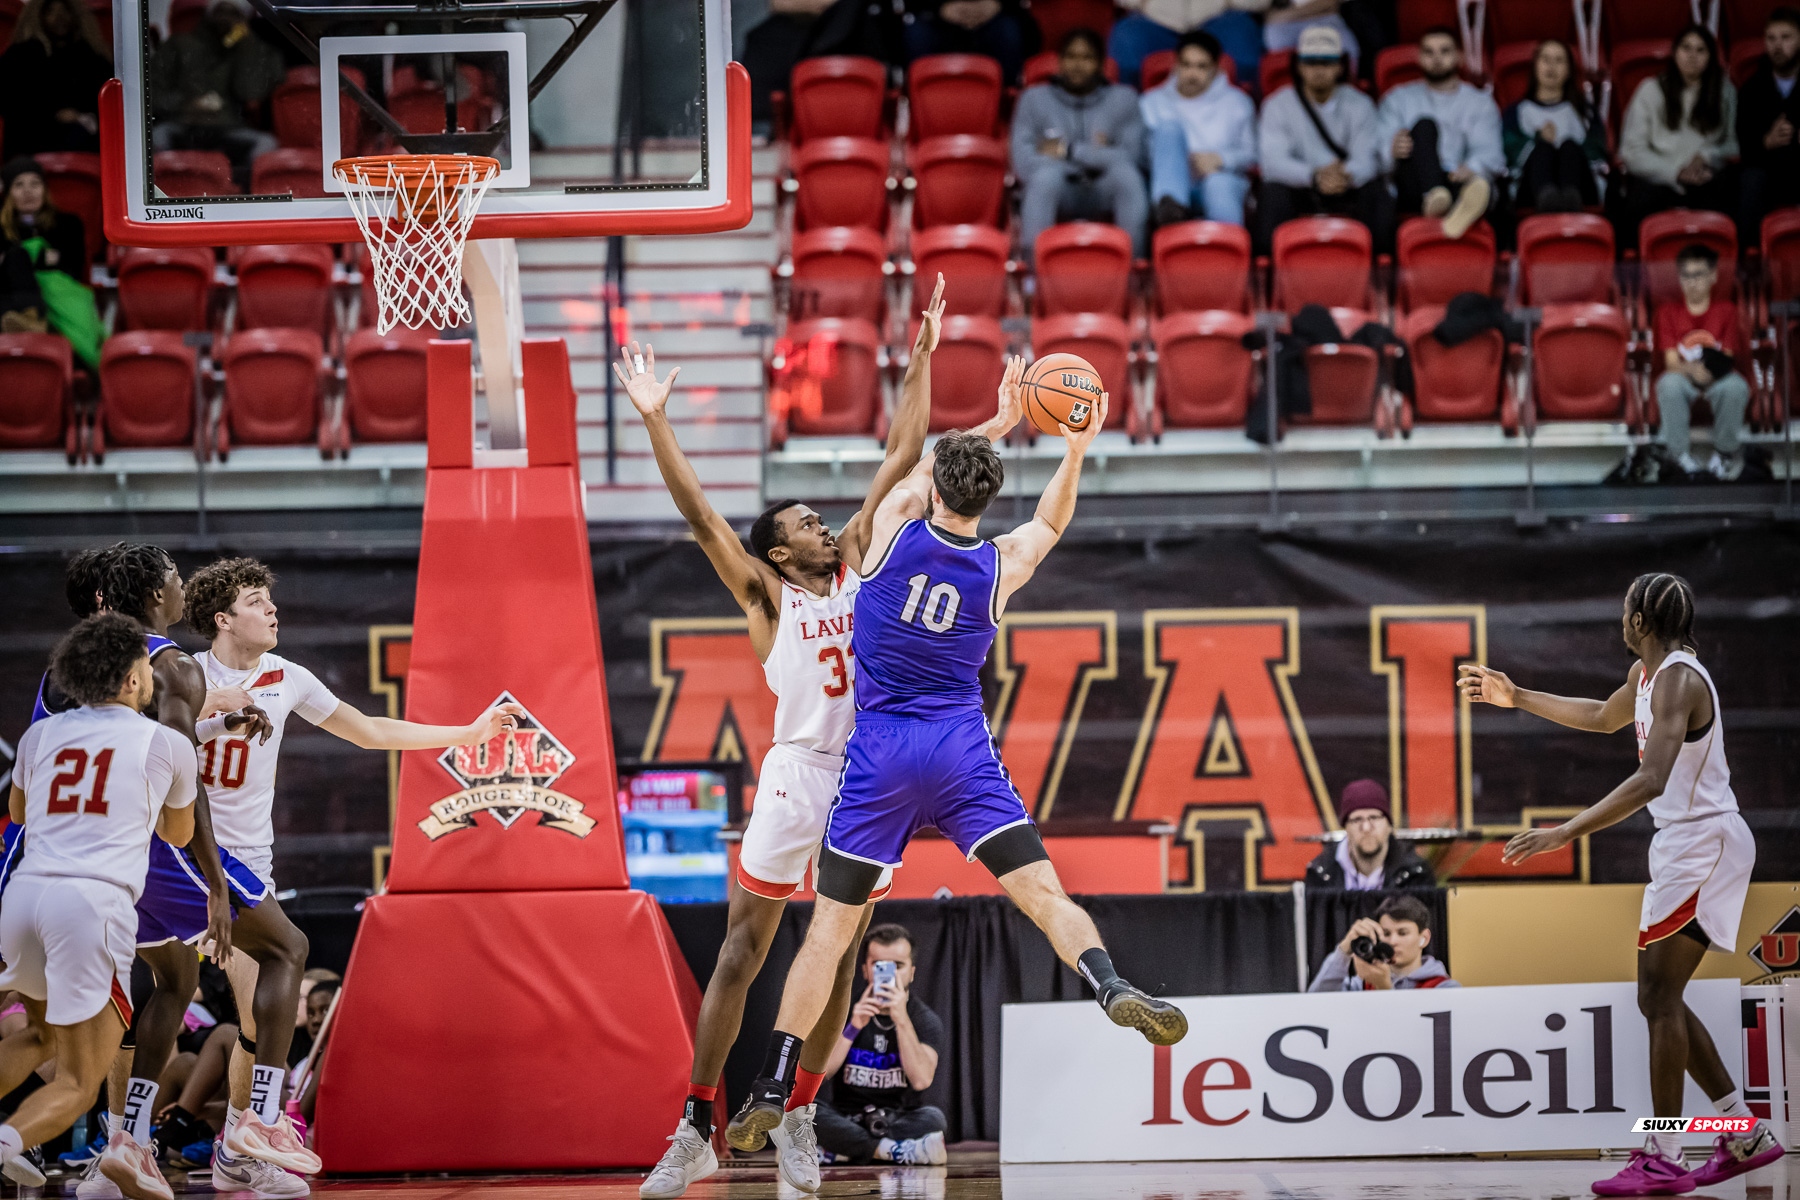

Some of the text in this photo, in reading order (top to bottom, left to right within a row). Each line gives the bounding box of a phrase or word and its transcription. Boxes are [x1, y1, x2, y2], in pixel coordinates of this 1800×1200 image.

[145, 206, 203, 221] SPALDING
[899, 572, 964, 634] 10
[817, 641, 856, 700] 3
[47, 747, 116, 818] 21
[200, 737, 250, 790] 10
